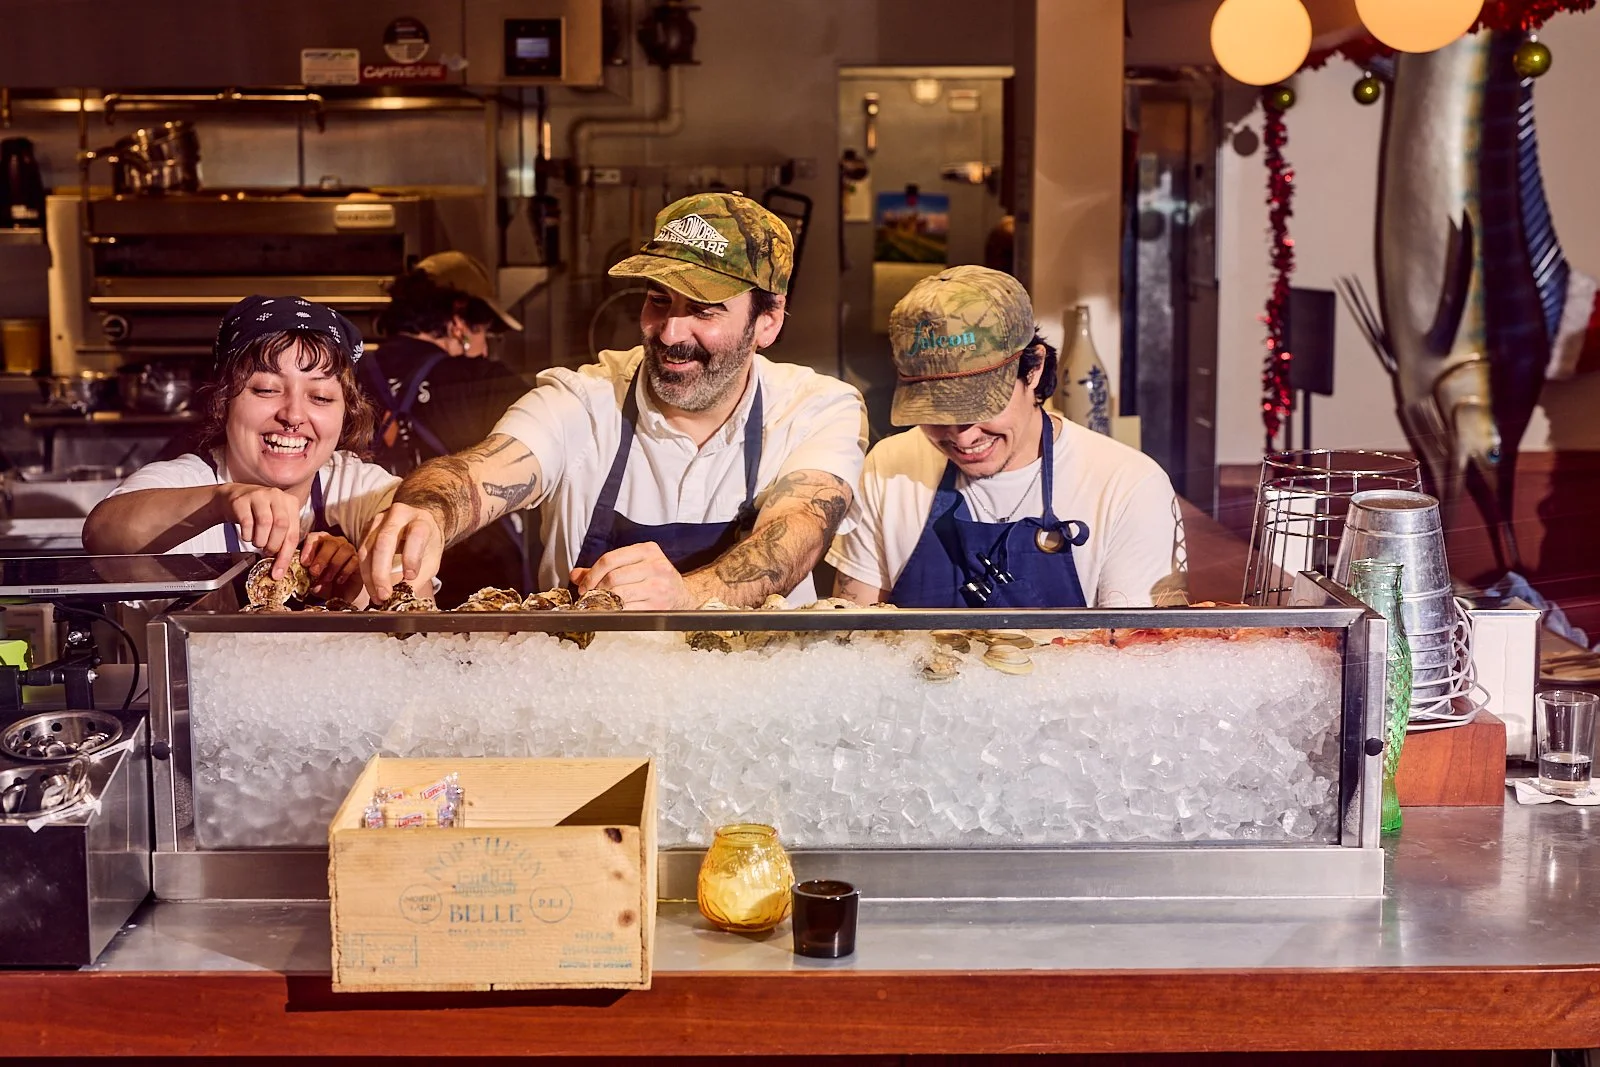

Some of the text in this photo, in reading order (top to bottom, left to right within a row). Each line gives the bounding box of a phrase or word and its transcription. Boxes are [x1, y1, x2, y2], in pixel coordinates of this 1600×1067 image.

[653, 228, 729, 258] HARDWARE
[905, 320, 976, 356] falcon
[920, 344, 977, 356] HAULING
[423, 784, 446, 800] Lance
[449, 904, 523, 923] BELLE
